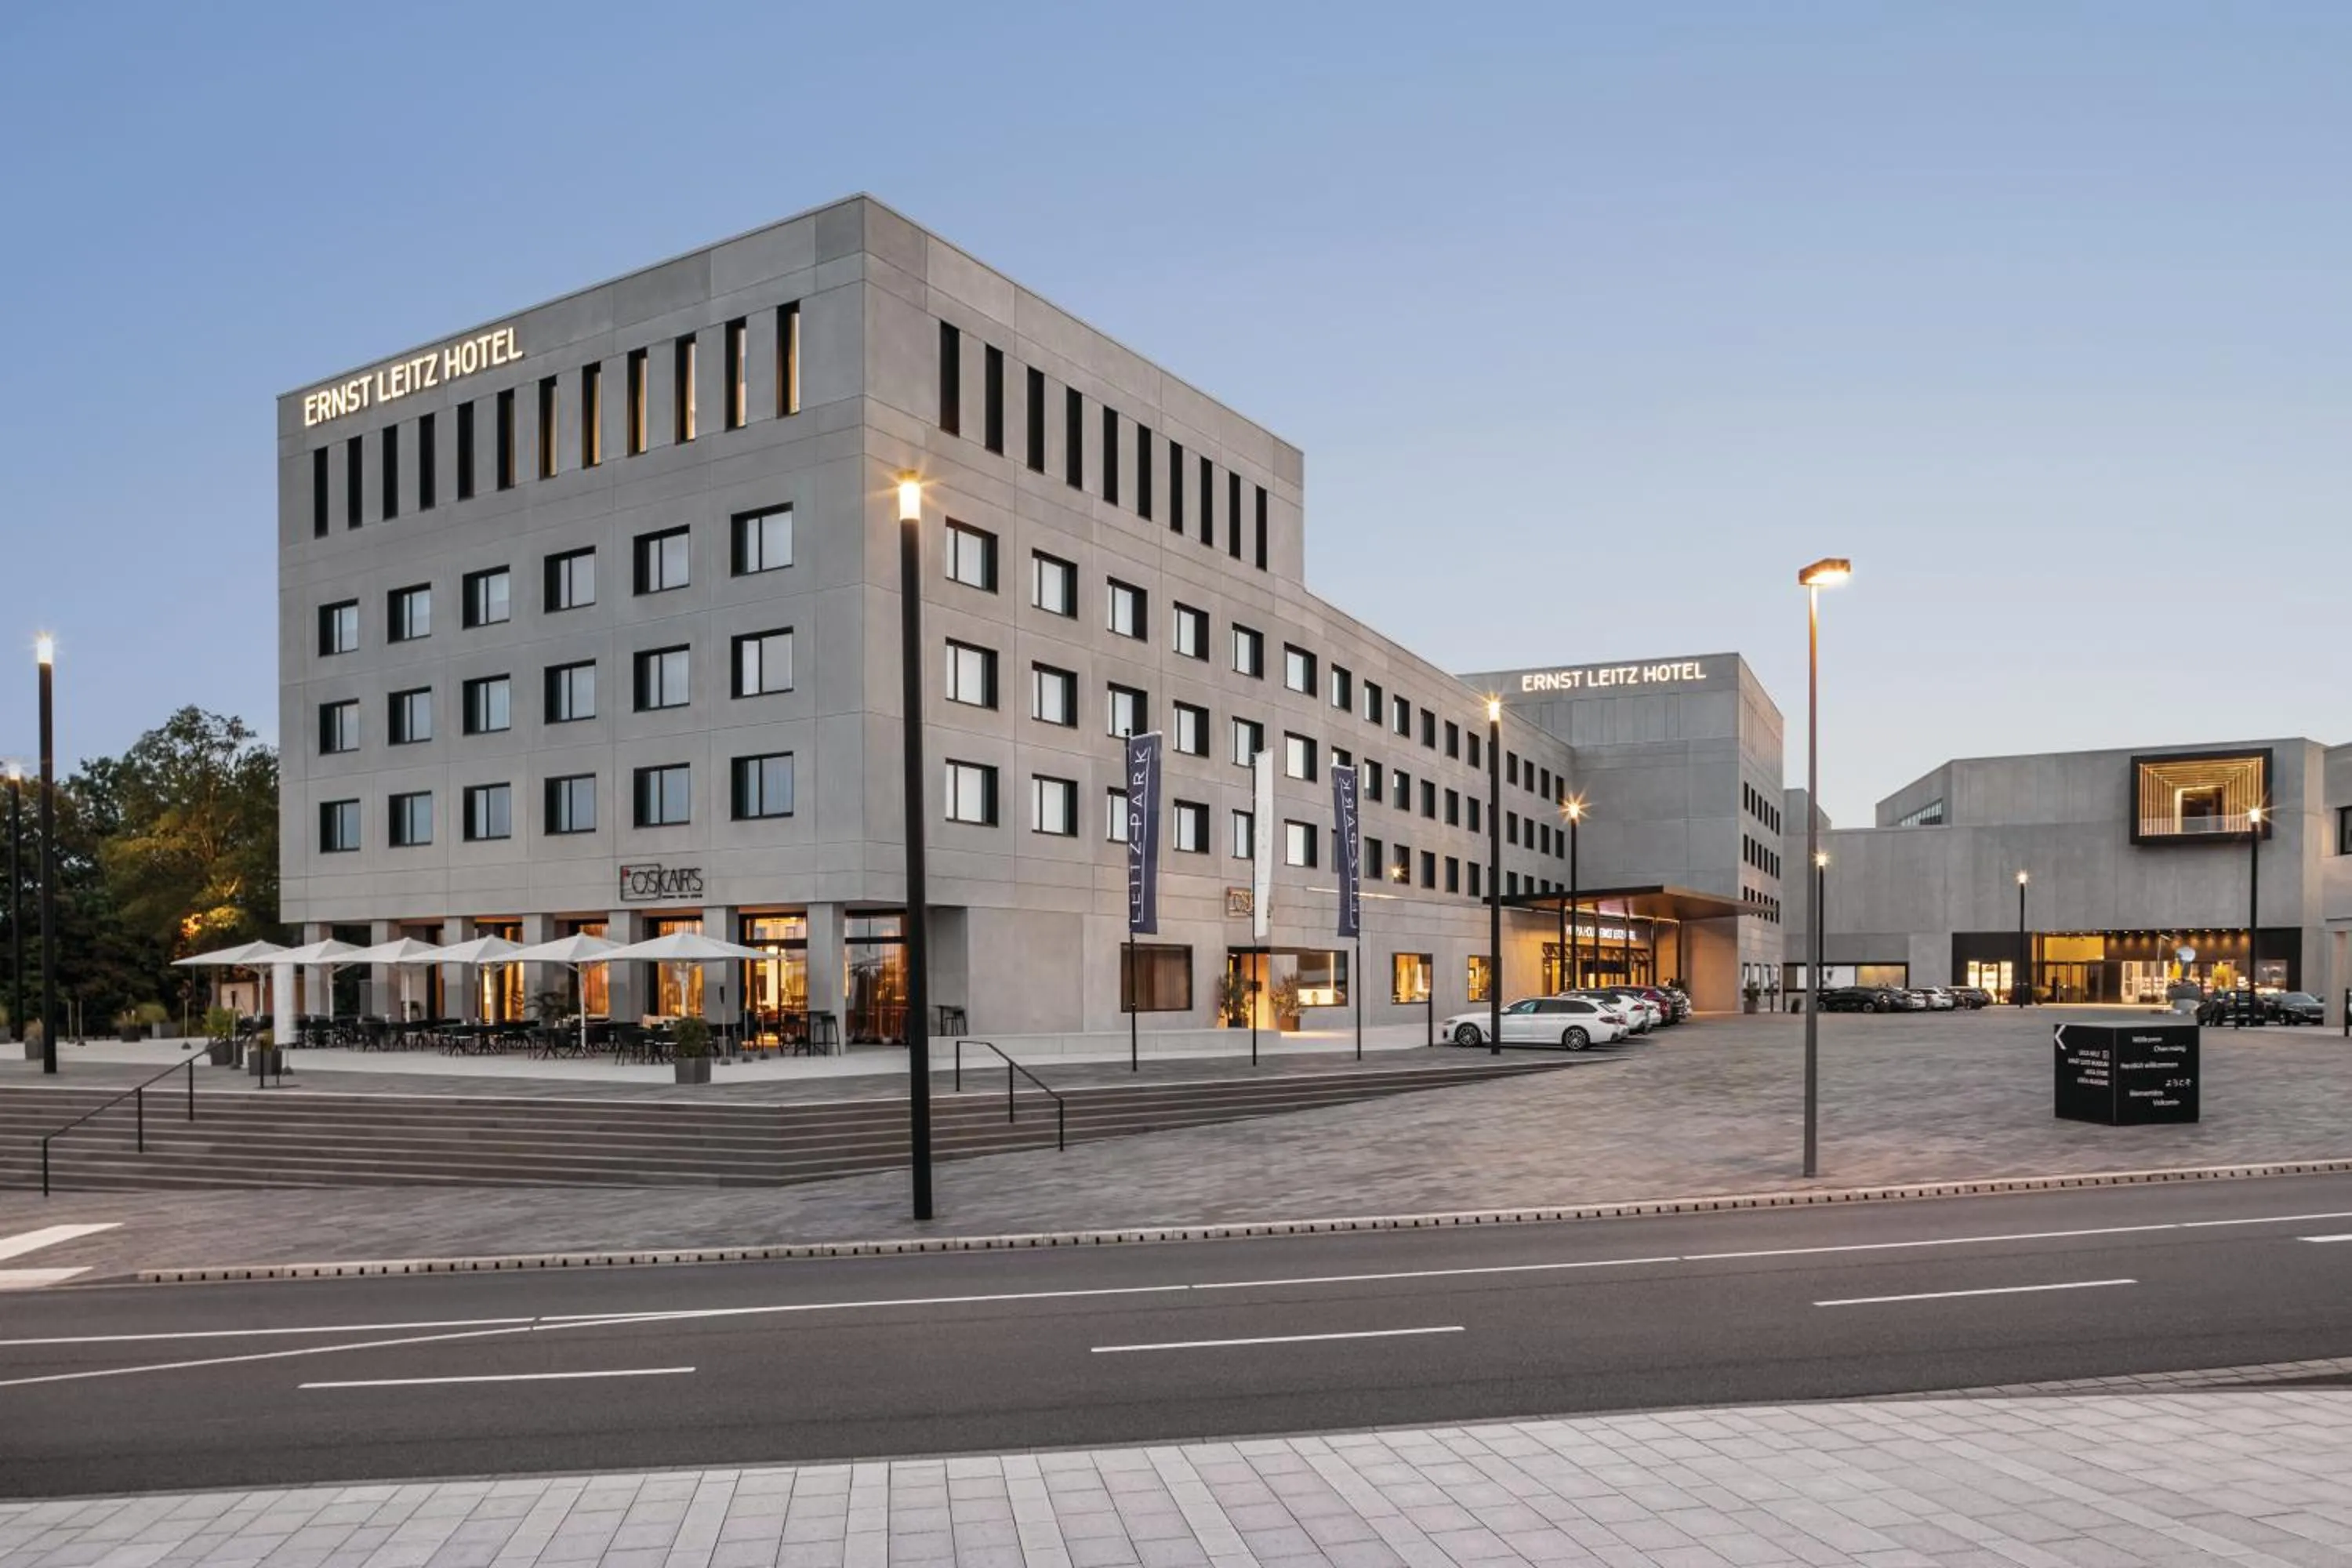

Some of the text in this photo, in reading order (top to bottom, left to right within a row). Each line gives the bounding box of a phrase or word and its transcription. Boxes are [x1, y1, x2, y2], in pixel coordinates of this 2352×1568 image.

[303, 327, 524, 427] ERNST LEITZ HOTEL
[1522, 662, 1707, 692] ERNST LEITZ HOTEL
